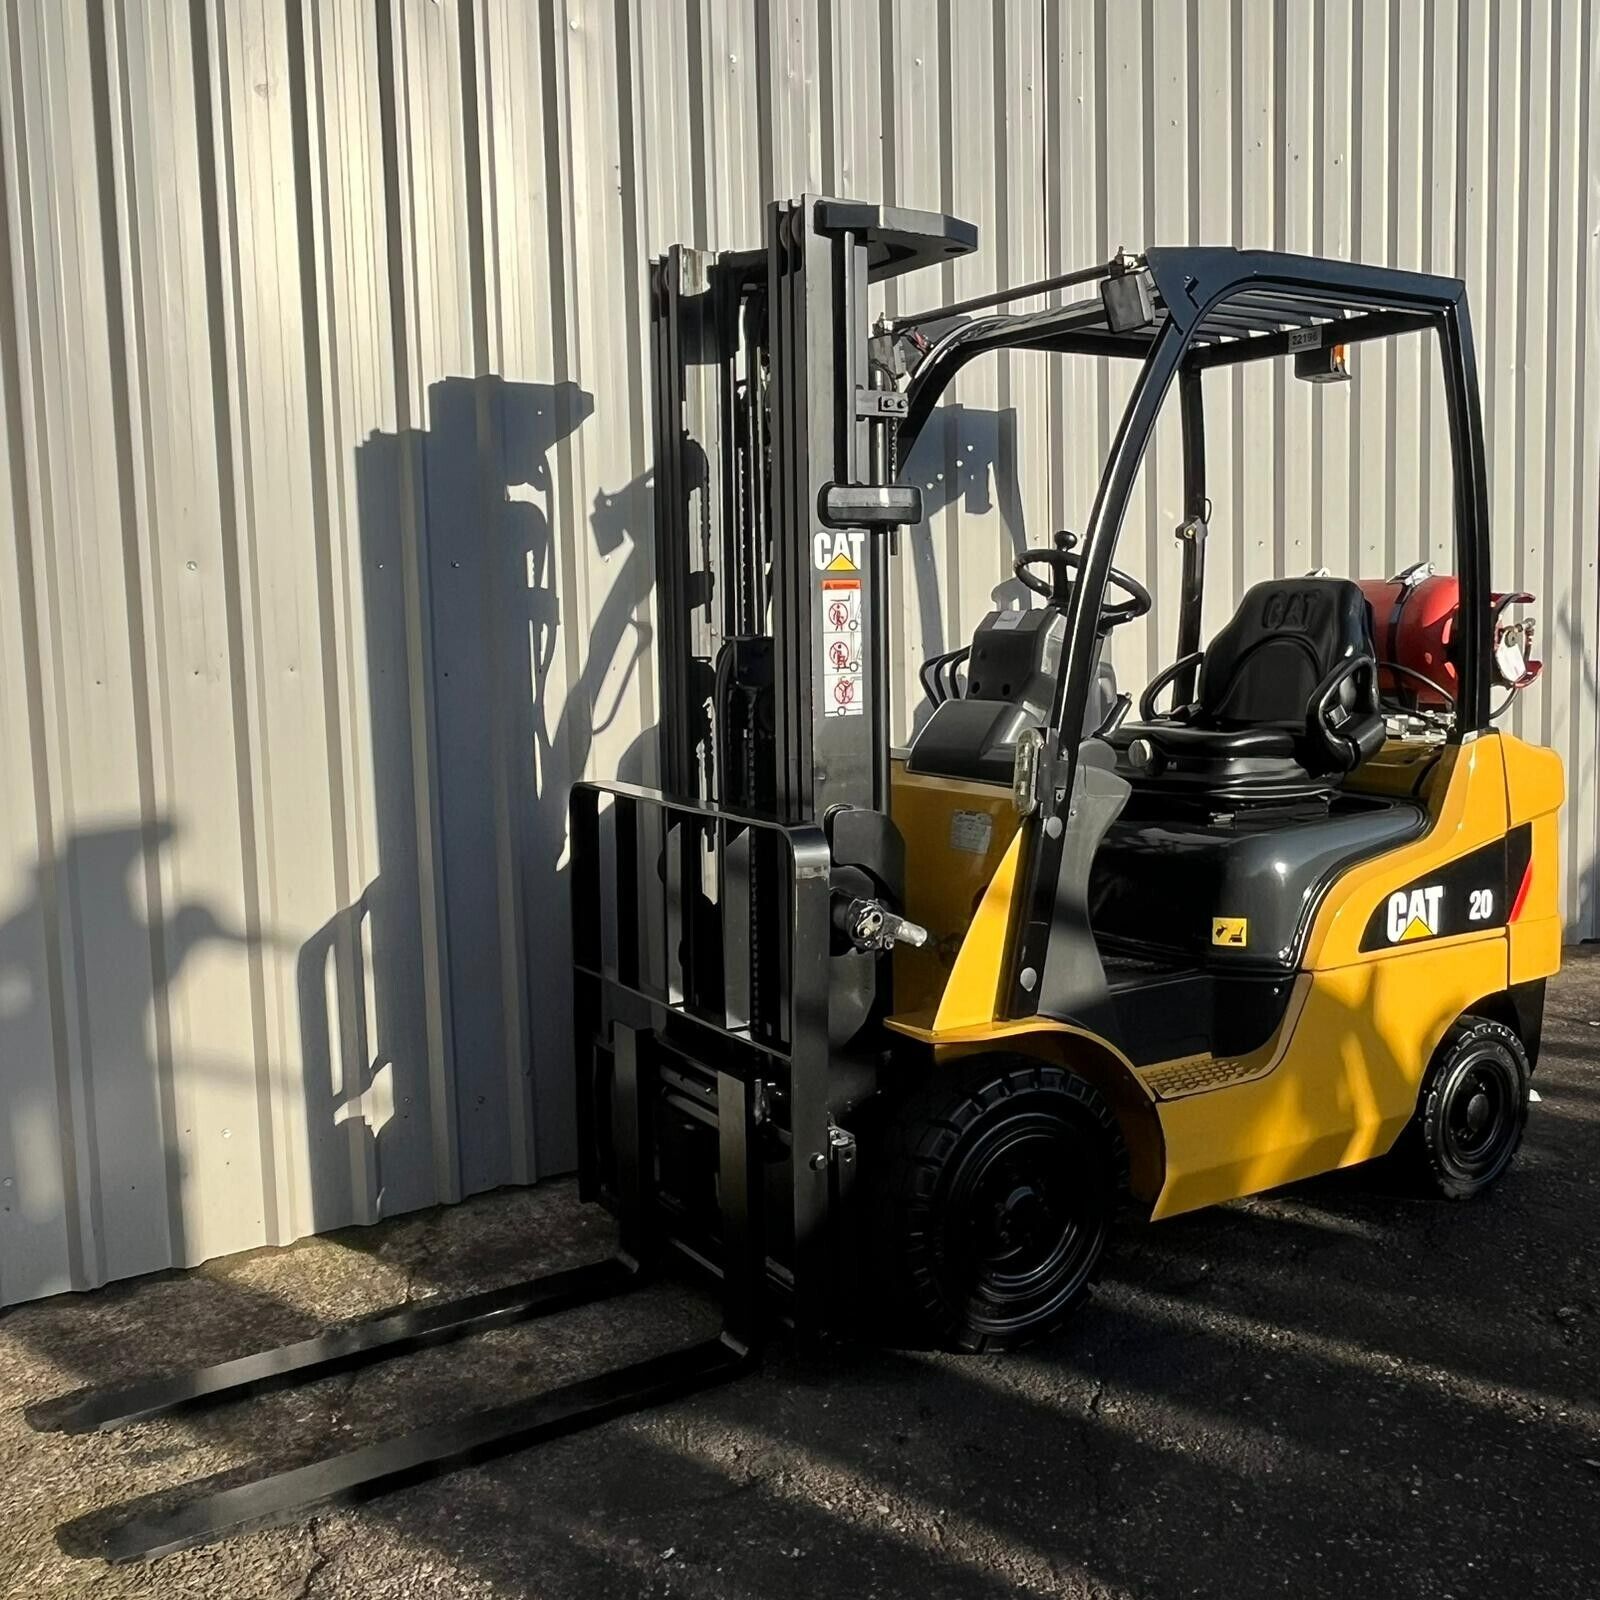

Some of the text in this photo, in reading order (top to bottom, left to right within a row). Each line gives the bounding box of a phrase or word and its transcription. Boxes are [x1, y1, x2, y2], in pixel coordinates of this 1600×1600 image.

[814, 532, 864, 570] CAT
[1262, 589, 1321, 631] CAT
[1386, 885, 1493, 943] CAT 20
